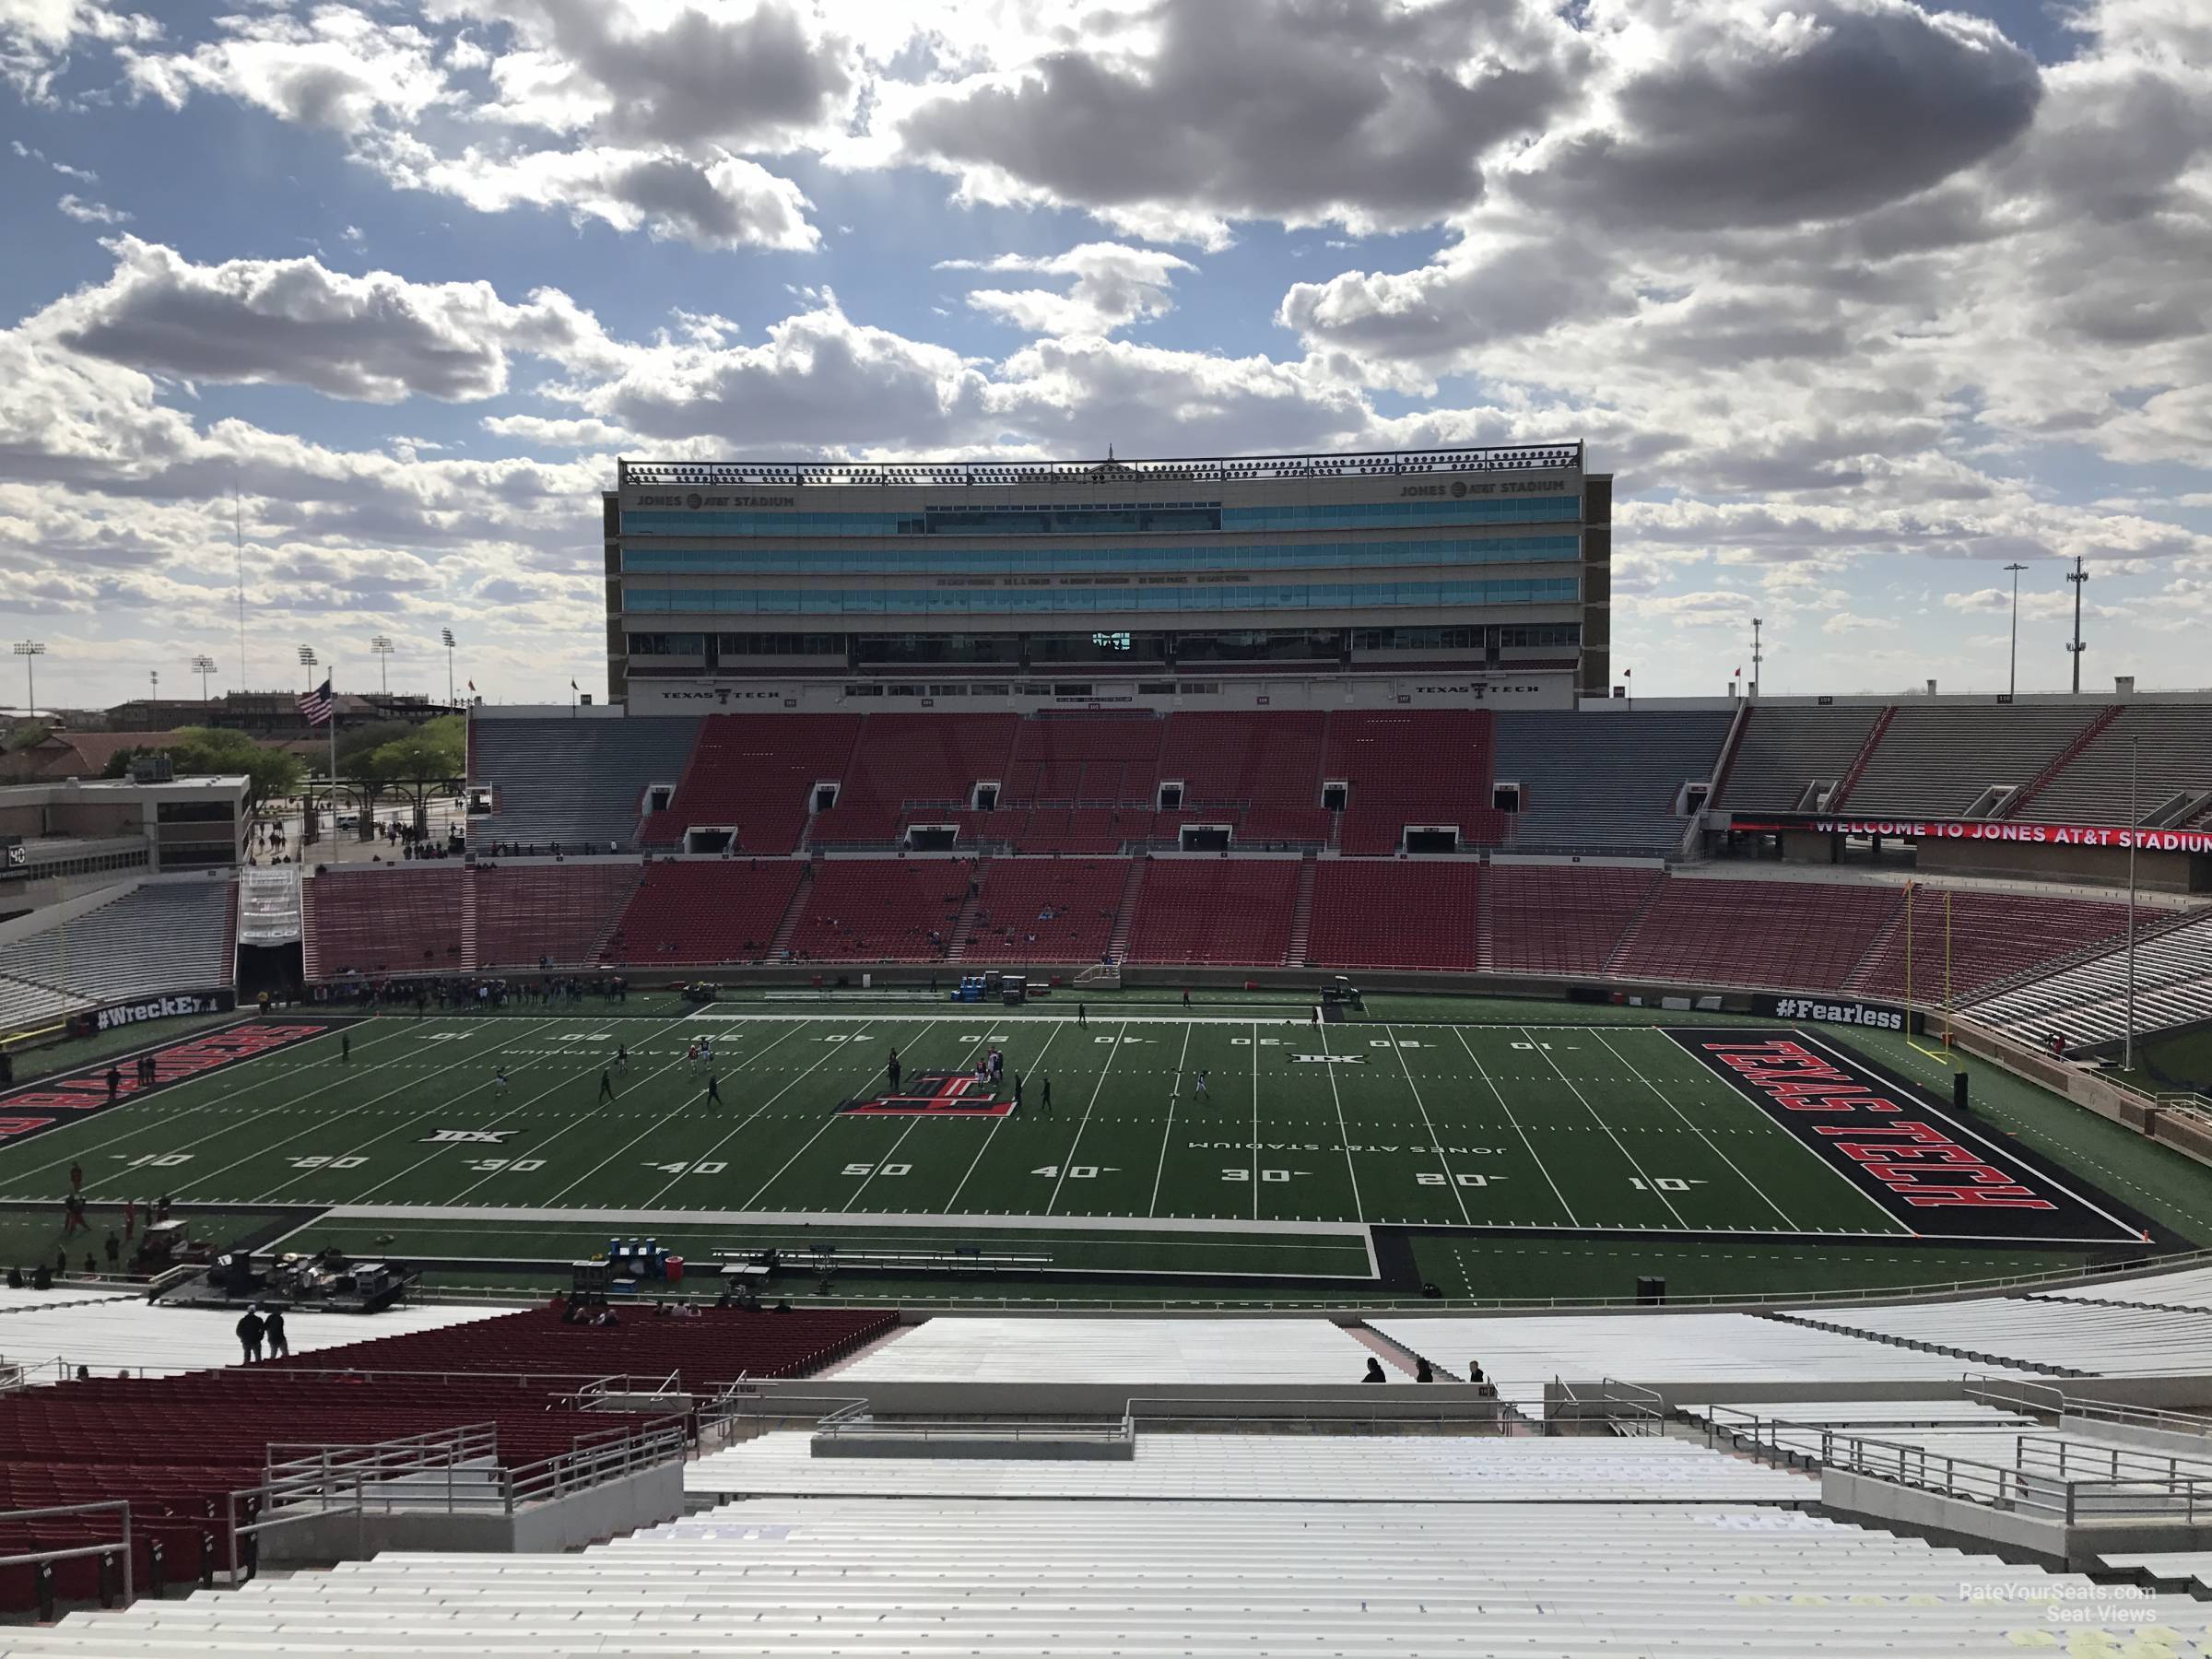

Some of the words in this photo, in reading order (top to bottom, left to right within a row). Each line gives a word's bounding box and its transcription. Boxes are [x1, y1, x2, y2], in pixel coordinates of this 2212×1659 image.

[1399, 485, 1445, 497] JONES
[1499, 479, 1565, 494] STADIUM
[637, 495, 682, 506] JONES
[735, 496, 794, 507] STADIUM
[1817, 820, 1926, 836] WELCOME
[1936, 823, 1963, 837] TO
[1972, 825, 2046, 841] JONES
[2054, 829, 2111, 846] AT&T
[10, 847, 26, 864] 40
[1776, 998, 1901, 1030] #Fearless
[824, 1034, 876, 1042] 40
[1094, 1036, 1144, 1044] 40
[1510, 1041, 1553, 1050] 10
[1701, 1041, 1903, 1112] TEXAS
[1812, 1121, 2060, 1210] TECH
[1188, 1142, 1319, 1151] STADIUM
[1329, 1144, 1400, 1152] AT&T
[1409, 1147, 1508, 1155] JONES
[127, 1154, 196, 1166] 10
[290, 1156, 371, 1169] 20
[470, 1159, 548, 1171] 30
[656, 1162, 729, 1175] 40
[840, 1163, 914, 1176] 50
[1030, 1165, 1100, 1178] 40
[1221, 1168, 1290, 1182] 30
[1415, 1172, 1488, 1187] 20
[1629, 1177, 1691, 1191] 10
